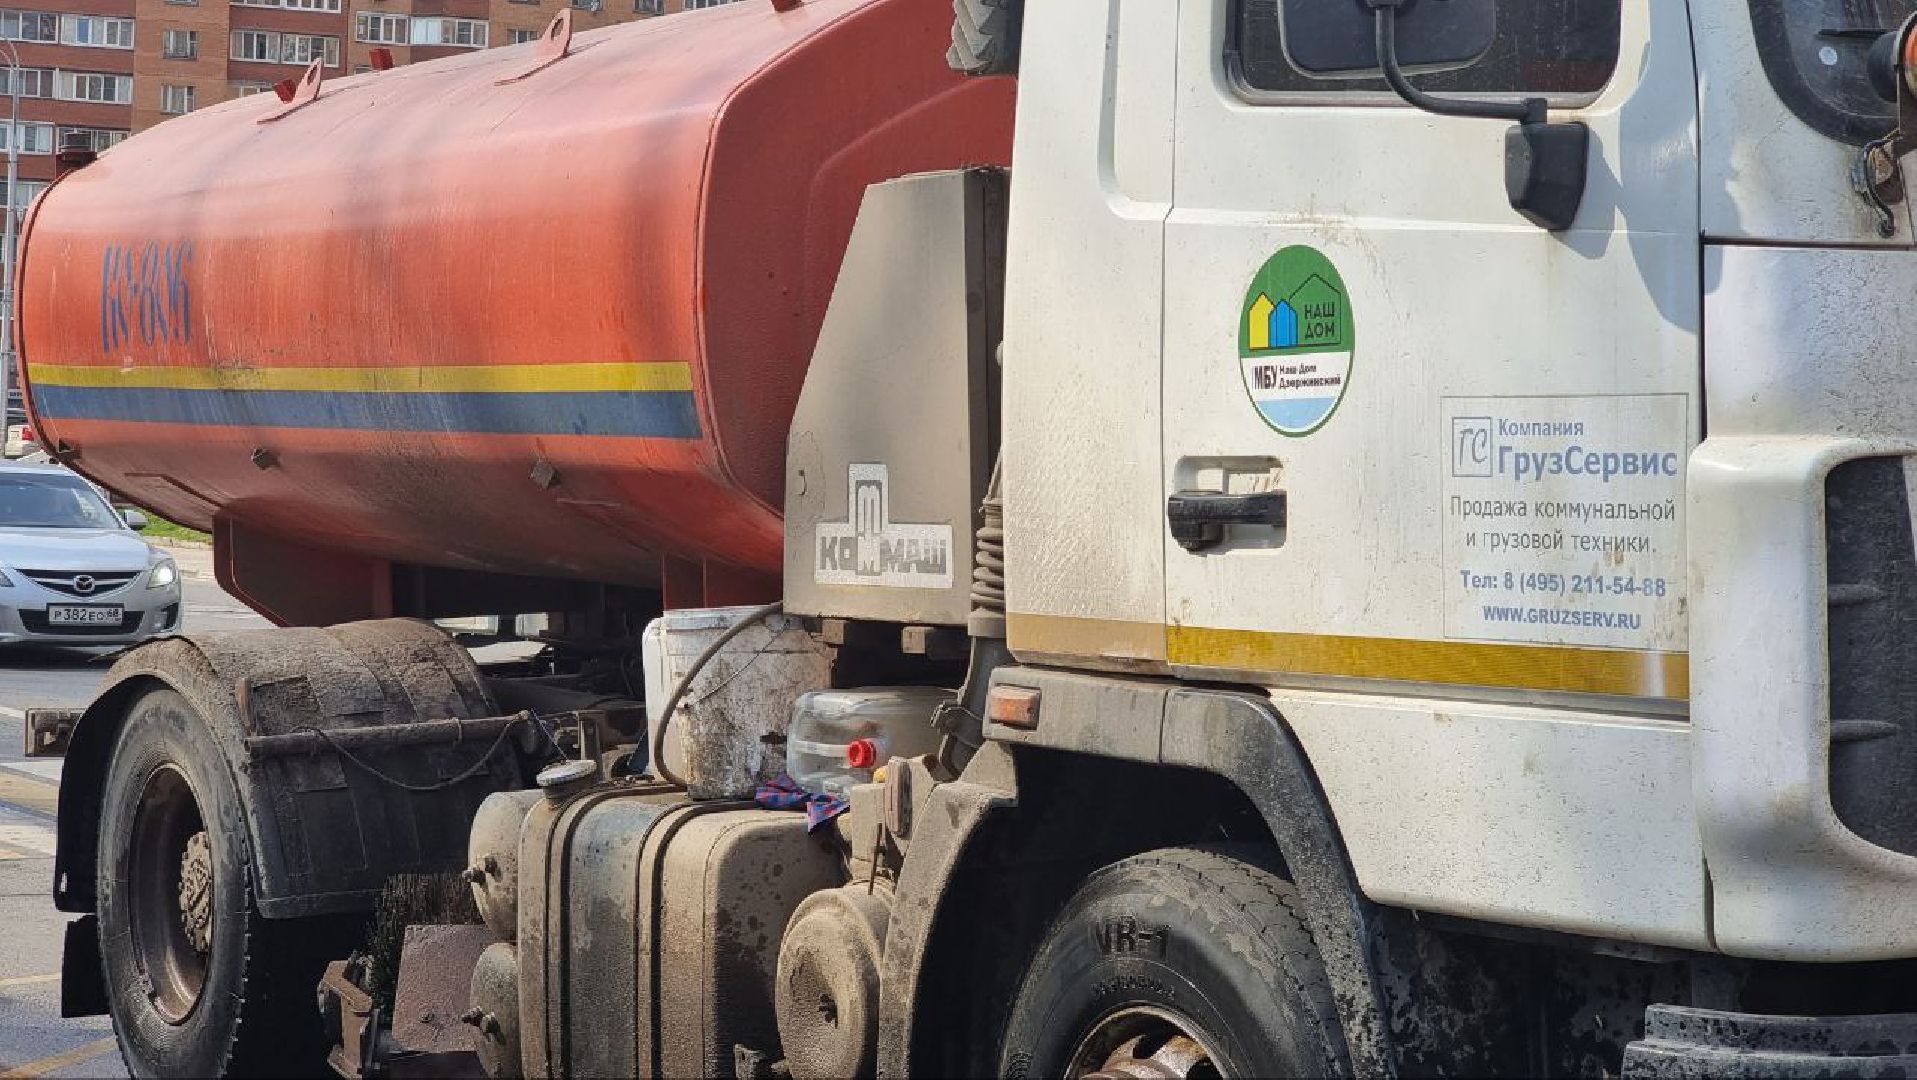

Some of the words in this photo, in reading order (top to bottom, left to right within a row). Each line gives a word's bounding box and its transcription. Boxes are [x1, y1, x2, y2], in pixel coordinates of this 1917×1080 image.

[1304, 301, 1335, 320] НАШ
[1304, 322, 1335, 339] ДОМ
[1254, 365, 1277, 390] МБУ
[1499, 418, 1584, 436] Компания
[1459, 428, 1488, 467] ГС
[1499, 445, 1678, 482] ГрузСервис
[1450, 495, 1527, 519] Продажа
[1534, 499, 1675, 524] коммунальной
[1466, 532, 1476, 547] и
[1483, 528, 1564, 552] грузовой
[1571, 534, 1657, 553] техники.
[1460, 569, 1498, 589] Тел:
[1504, 571, 1514, 590] 8
[1520, 572, 1565, 597] (495)
[1571, 574, 1666, 598] 211-54-88
[1483, 605, 1642, 630] WWW.GRUZSERV.RU
